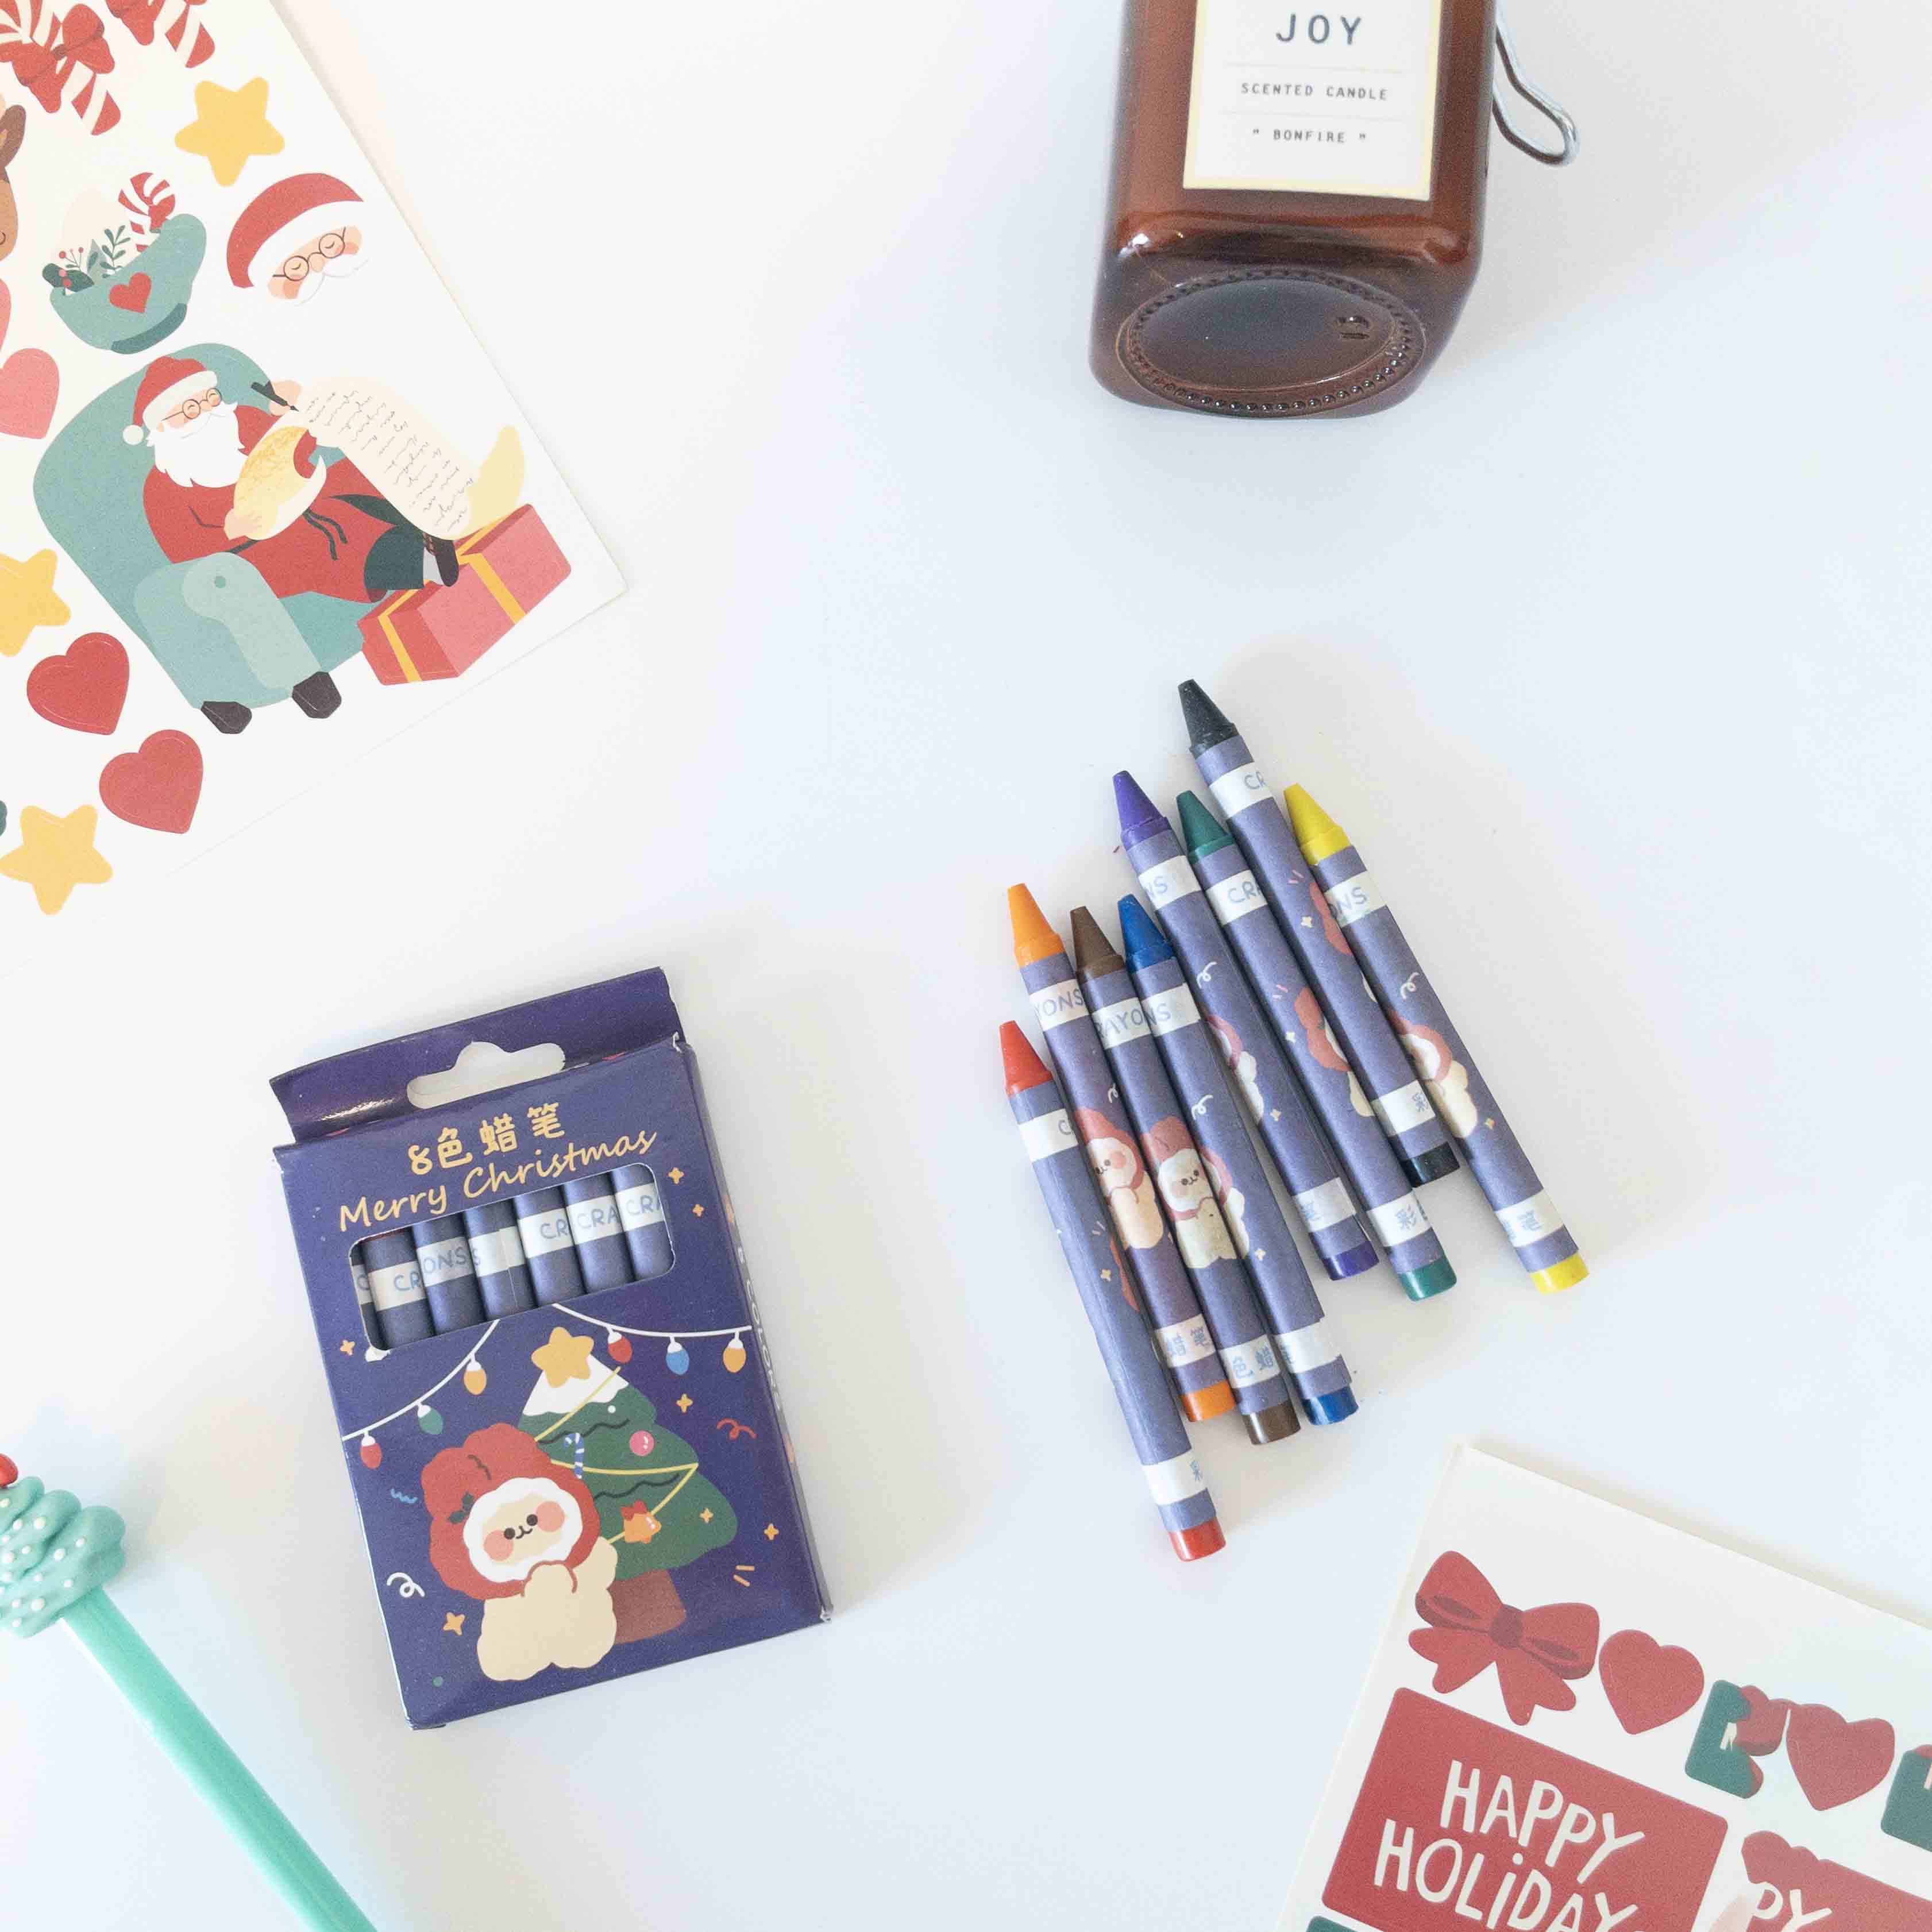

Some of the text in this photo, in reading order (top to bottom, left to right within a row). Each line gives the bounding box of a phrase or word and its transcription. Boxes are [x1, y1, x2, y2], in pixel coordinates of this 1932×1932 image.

[1275, 13, 1362, 45] JOY
[1241, 82, 1388, 101] SCENTED CANDLE
[1227, 881, 1262, 904] CR
[407, 1102, 565, 1176] 8色蜡笔
[339, 1130, 658, 1233] Merry Christmas
[1440, 1760, 1645, 1884] HAPPY
